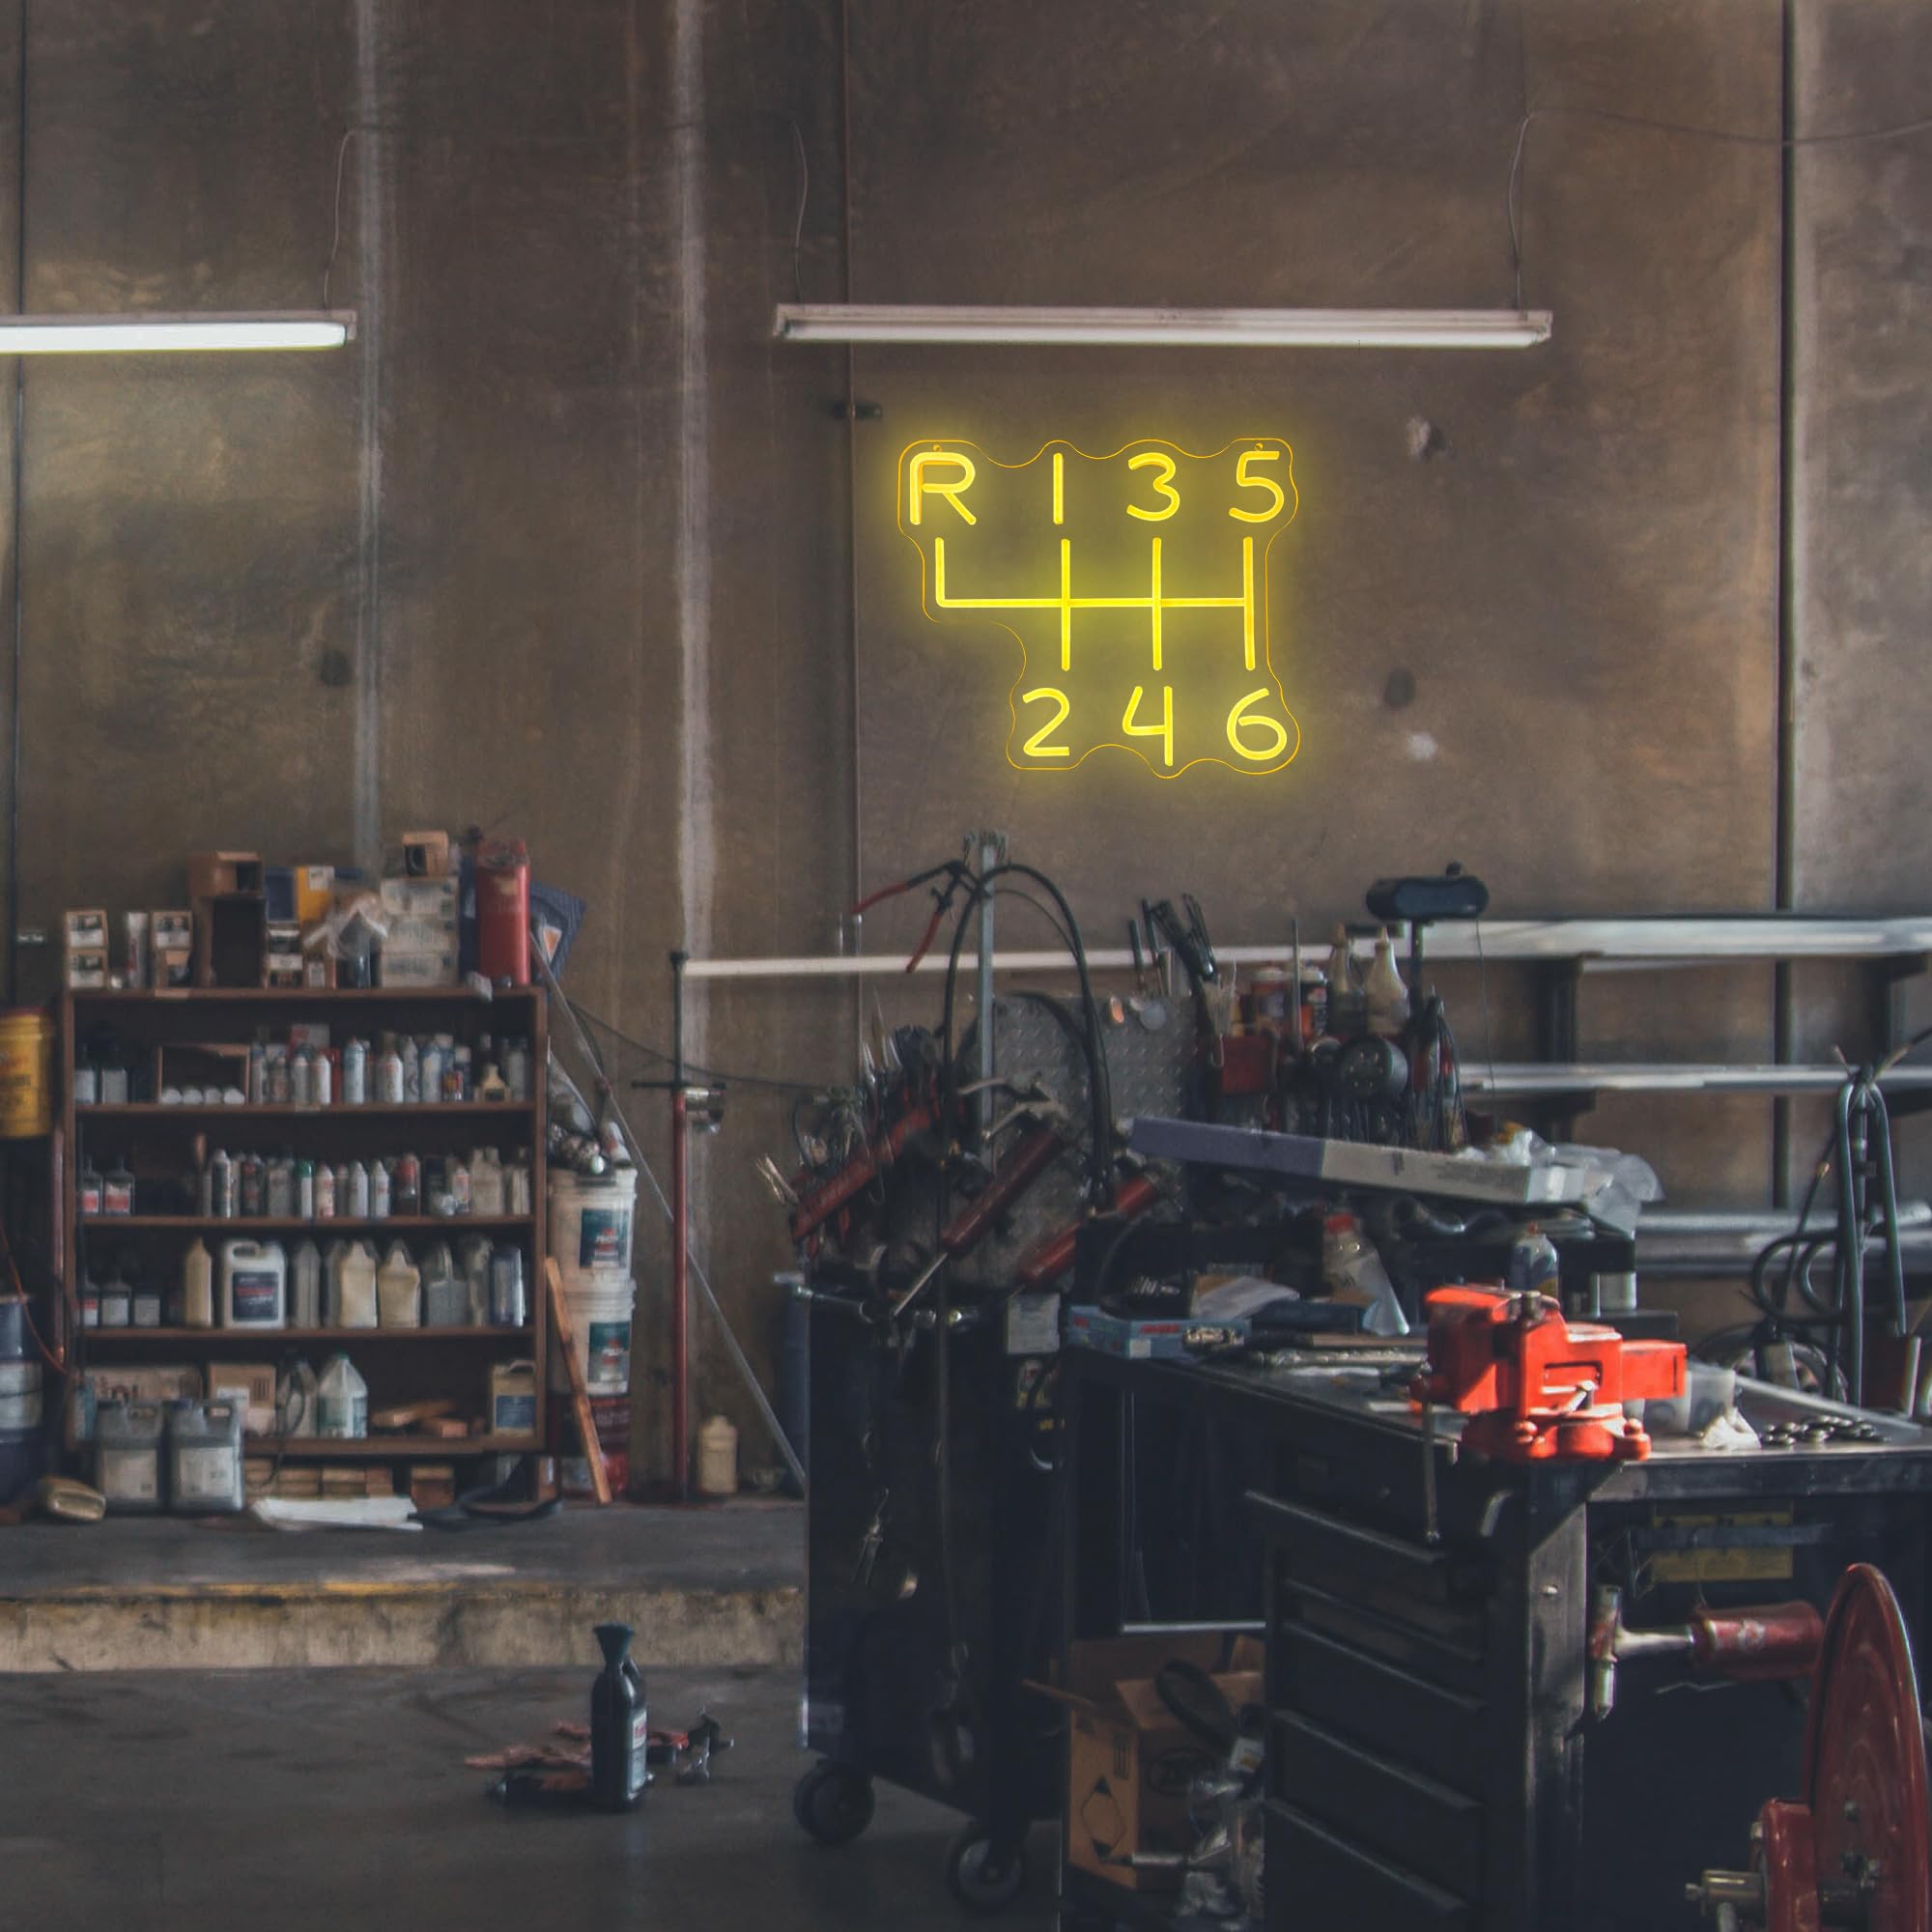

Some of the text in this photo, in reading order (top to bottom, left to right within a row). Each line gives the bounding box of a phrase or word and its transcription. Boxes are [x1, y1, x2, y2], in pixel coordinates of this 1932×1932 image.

[909, 450, 1285, 525] R 1 3 5
[1022, 685, 1288, 767] 2 4 6
